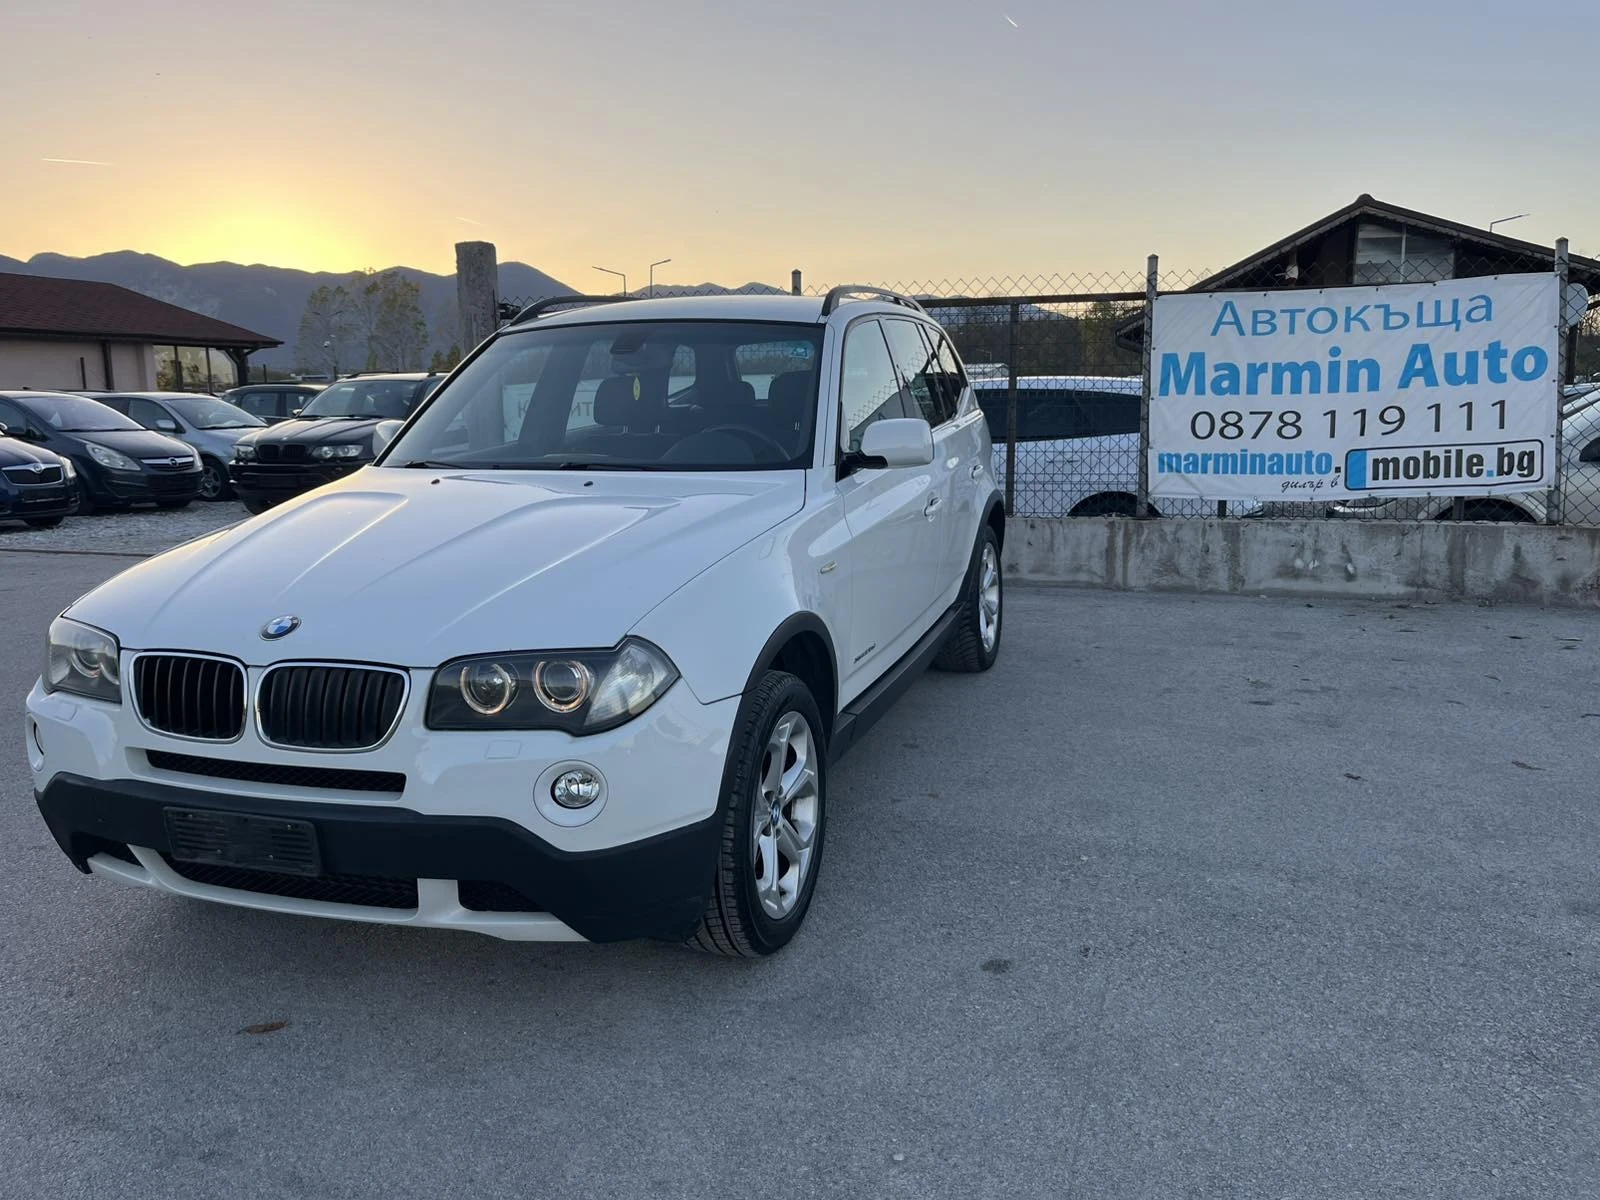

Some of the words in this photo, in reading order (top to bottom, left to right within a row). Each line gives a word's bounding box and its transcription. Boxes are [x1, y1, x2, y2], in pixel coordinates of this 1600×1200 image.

[1210, 294, 1494, 337] Автокъща
[1158, 345, 1382, 398] Marmin
[1396, 339, 1550, 390] Auto
[1190, 409, 1303, 440] 0878
[1322, 405, 1406, 438] 119
[1426, 399, 1506, 433] 111
[1157, 448, 1342, 476] marminauto.
[1371, 447, 1536, 481] mobile.bg
[1281, 478, 1324, 493] дилър
